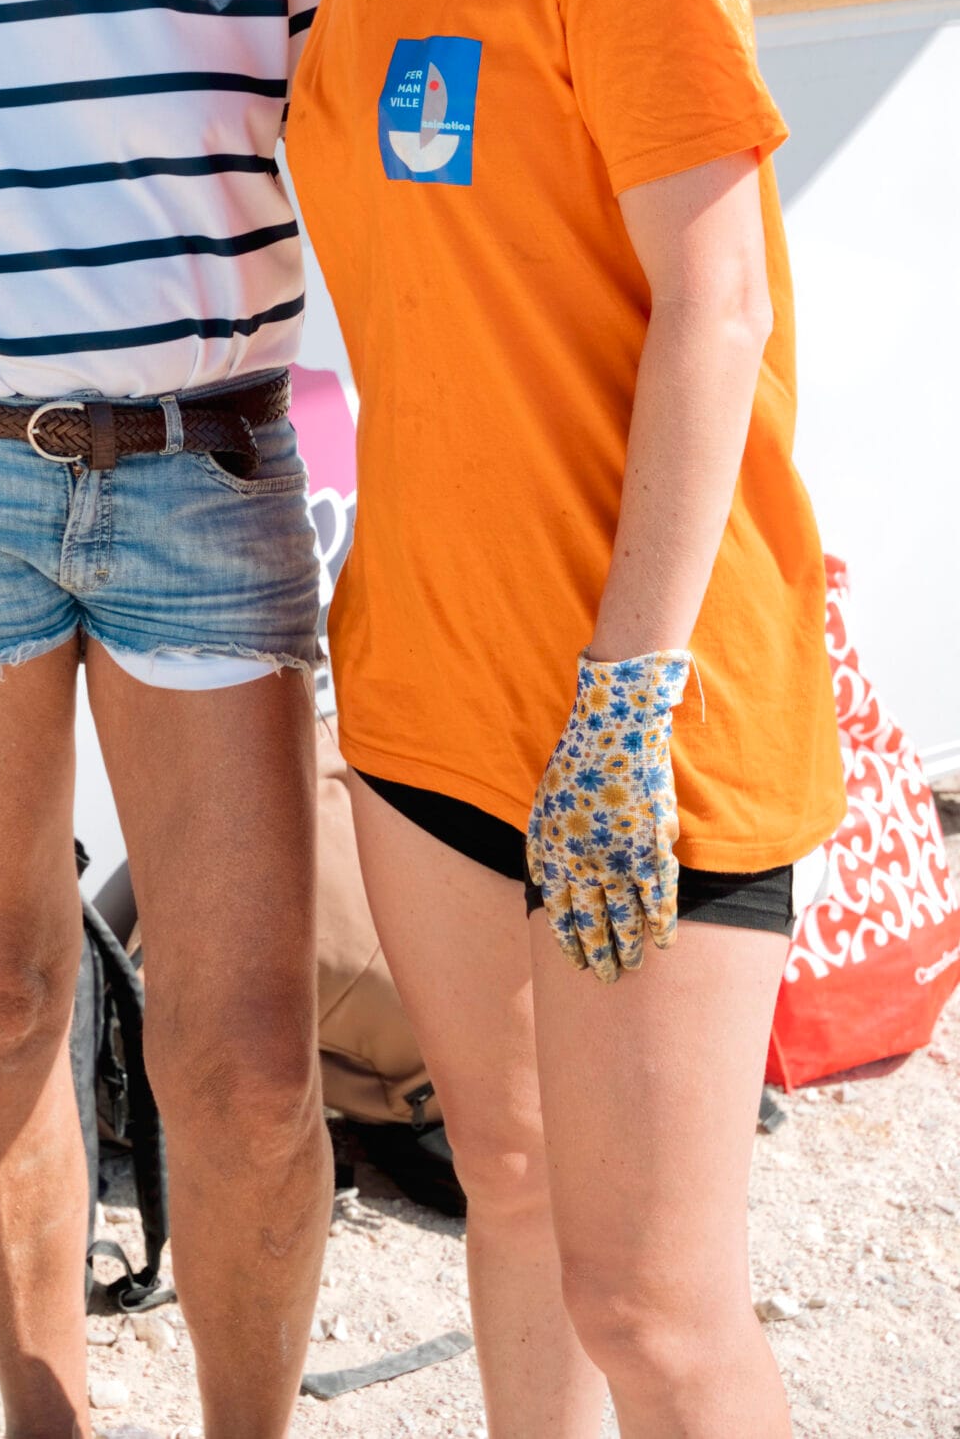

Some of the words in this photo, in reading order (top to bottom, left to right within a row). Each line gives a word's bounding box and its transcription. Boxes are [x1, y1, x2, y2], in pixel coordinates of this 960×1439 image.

[404, 70, 423, 80] FER
[397, 83, 421, 93] MAN
[390, 96, 420, 108] VILLE
